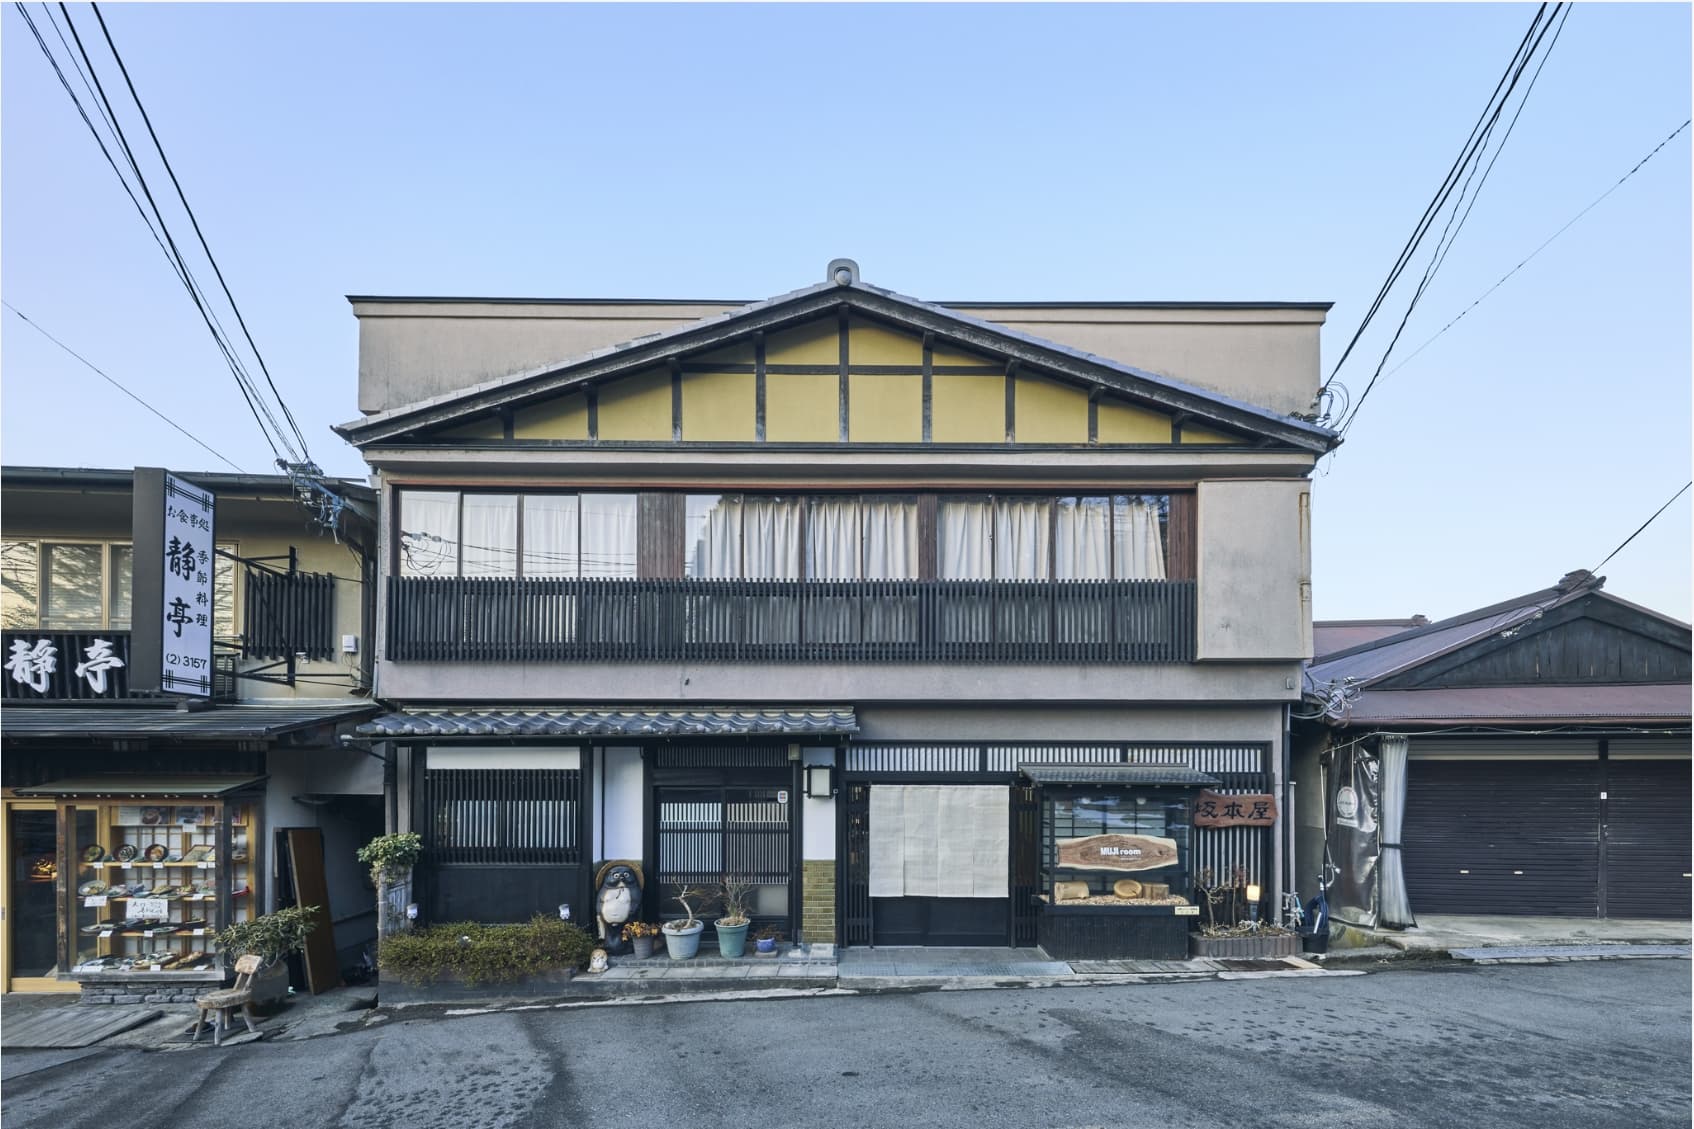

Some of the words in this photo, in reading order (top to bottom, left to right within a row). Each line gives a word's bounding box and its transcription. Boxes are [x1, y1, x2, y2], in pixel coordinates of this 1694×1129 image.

[168, 505, 209, 532] お食事処
[166, 536, 195, 638] 静亭
[195, 550, 209, 628] 季節料理
[4, 639, 125, 693] 静亭
[183, 656, 207, 670] 3157
[1196, 801, 1272, 820] 坂本屋
[1100, 846, 1119, 856] MUJI
